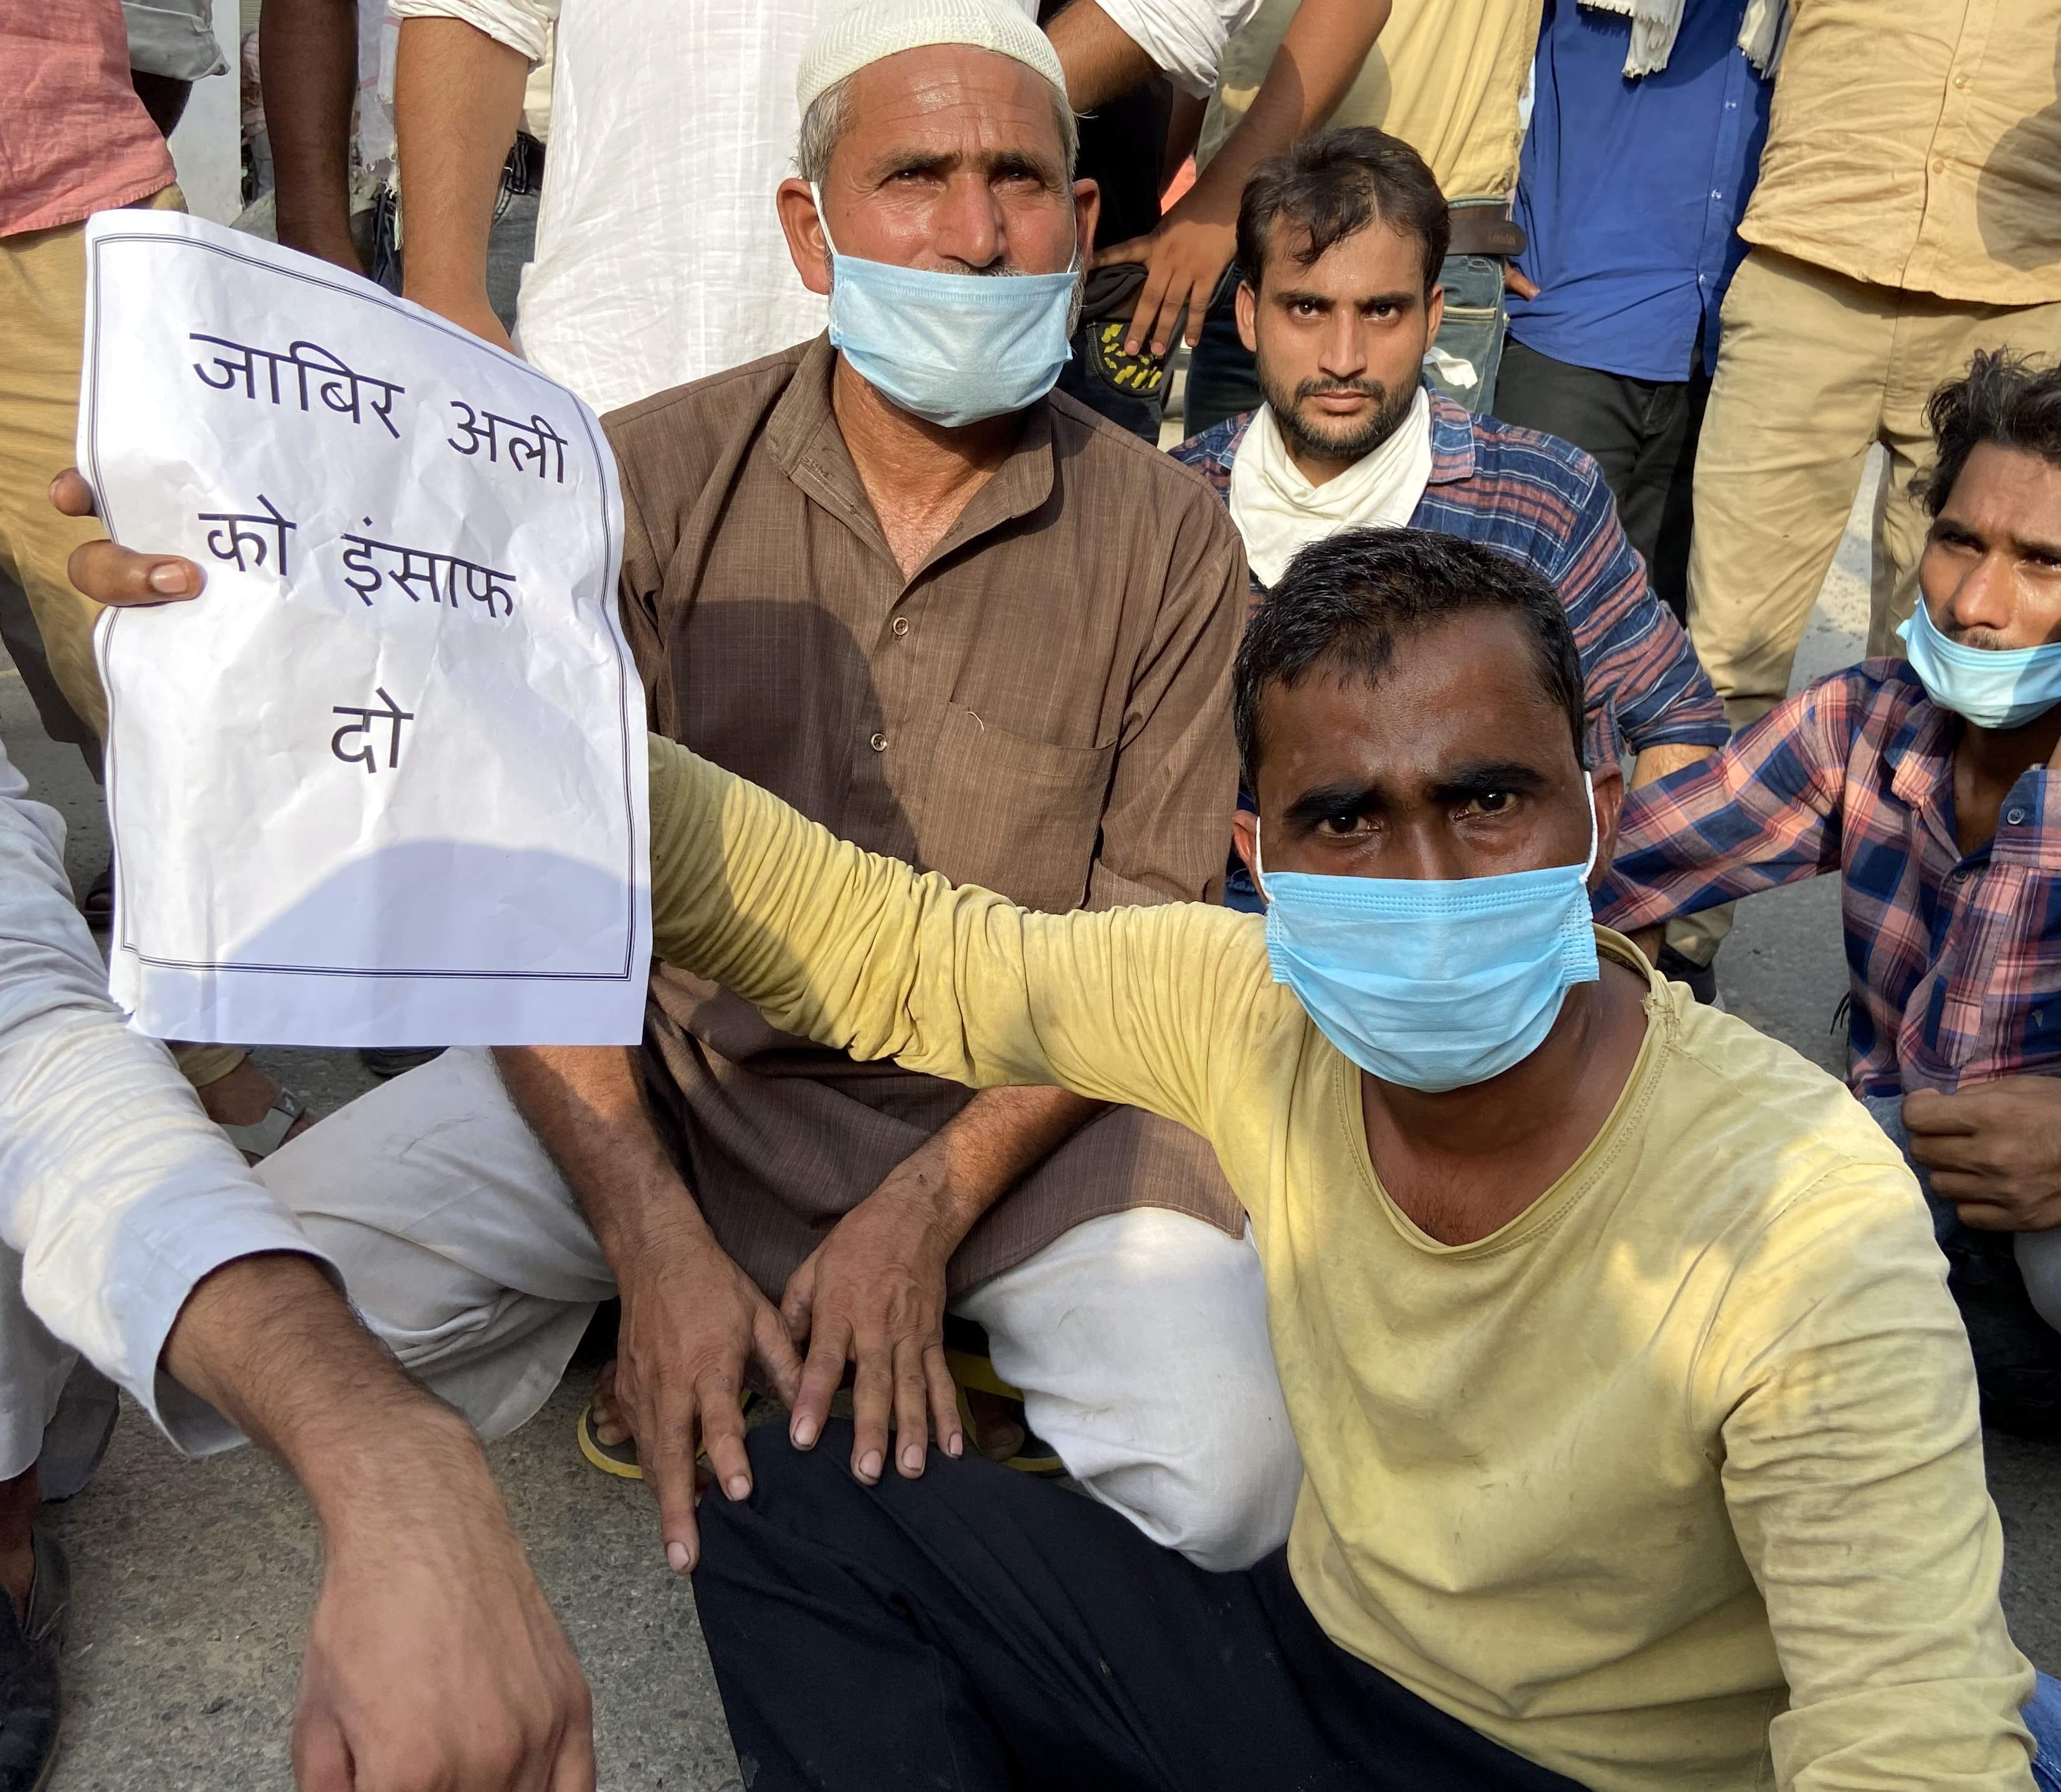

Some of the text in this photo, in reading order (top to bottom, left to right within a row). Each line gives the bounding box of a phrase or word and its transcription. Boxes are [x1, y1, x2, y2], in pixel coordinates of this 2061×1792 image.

[189, 333, 568, 484] जाबिर अली
[198, 494, 516, 618] को इंसाफ
[331, 687, 414, 773] दो
